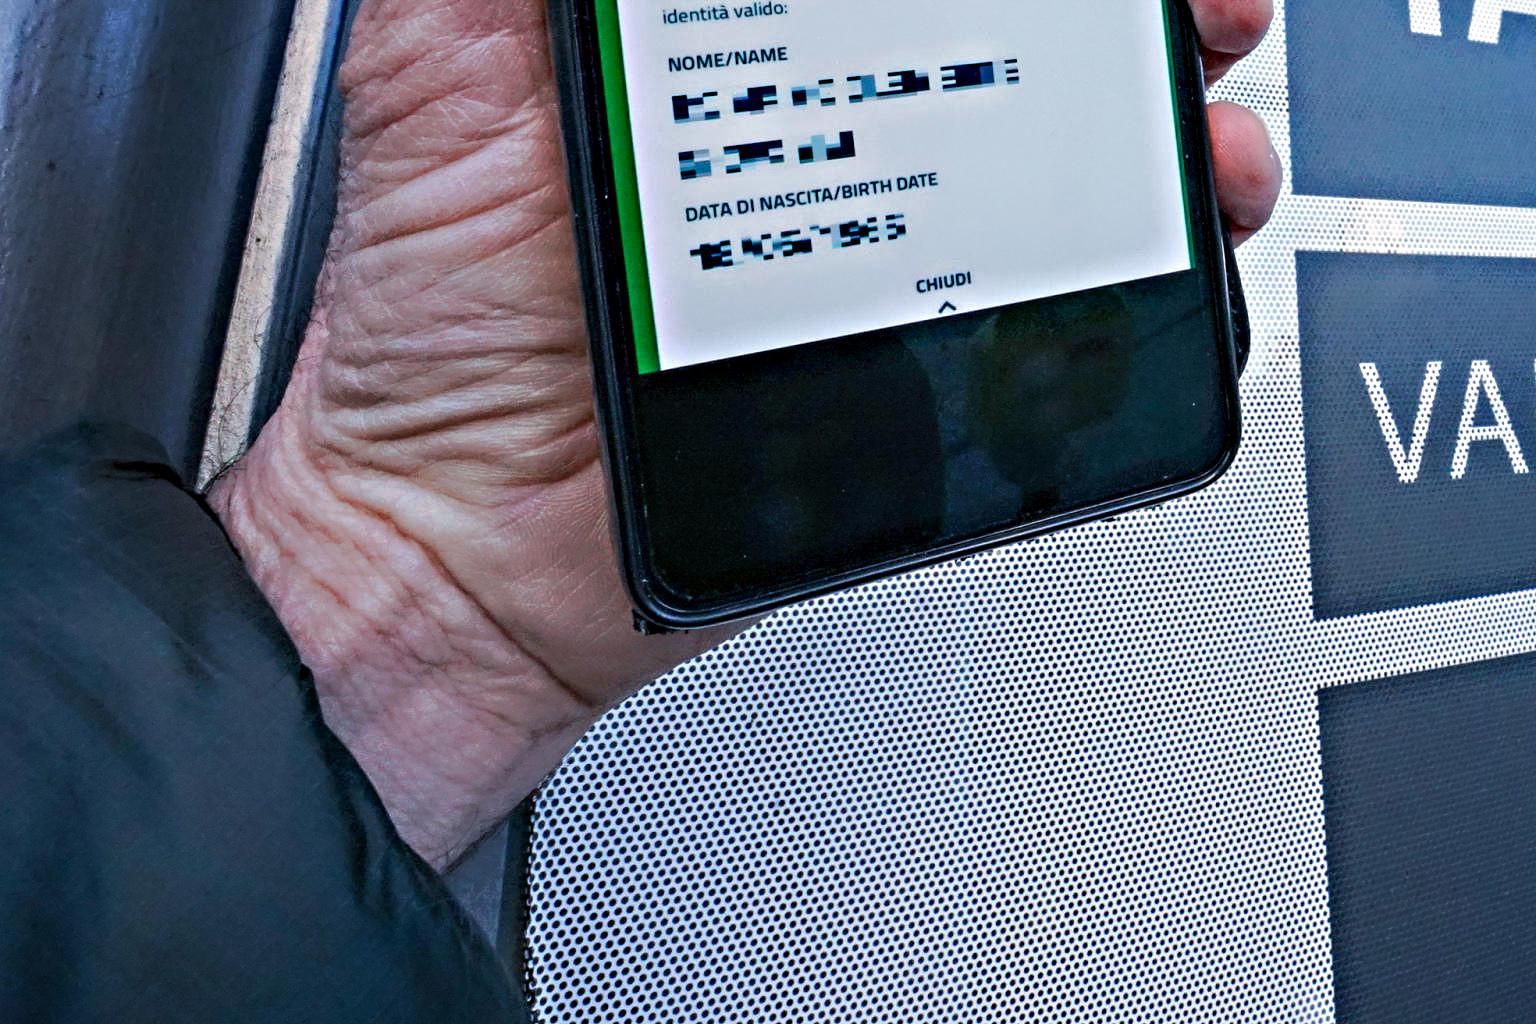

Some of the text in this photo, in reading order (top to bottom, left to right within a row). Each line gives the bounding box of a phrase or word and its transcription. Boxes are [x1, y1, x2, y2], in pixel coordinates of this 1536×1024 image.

[662, 0, 788, 25] identità valido:
[668, 46, 788, 73] NOME/NAME
[685, 172, 939, 223] DATA DI NASCITA/BIRTH DATE
[915, 270, 972, 294] CHIUDI
